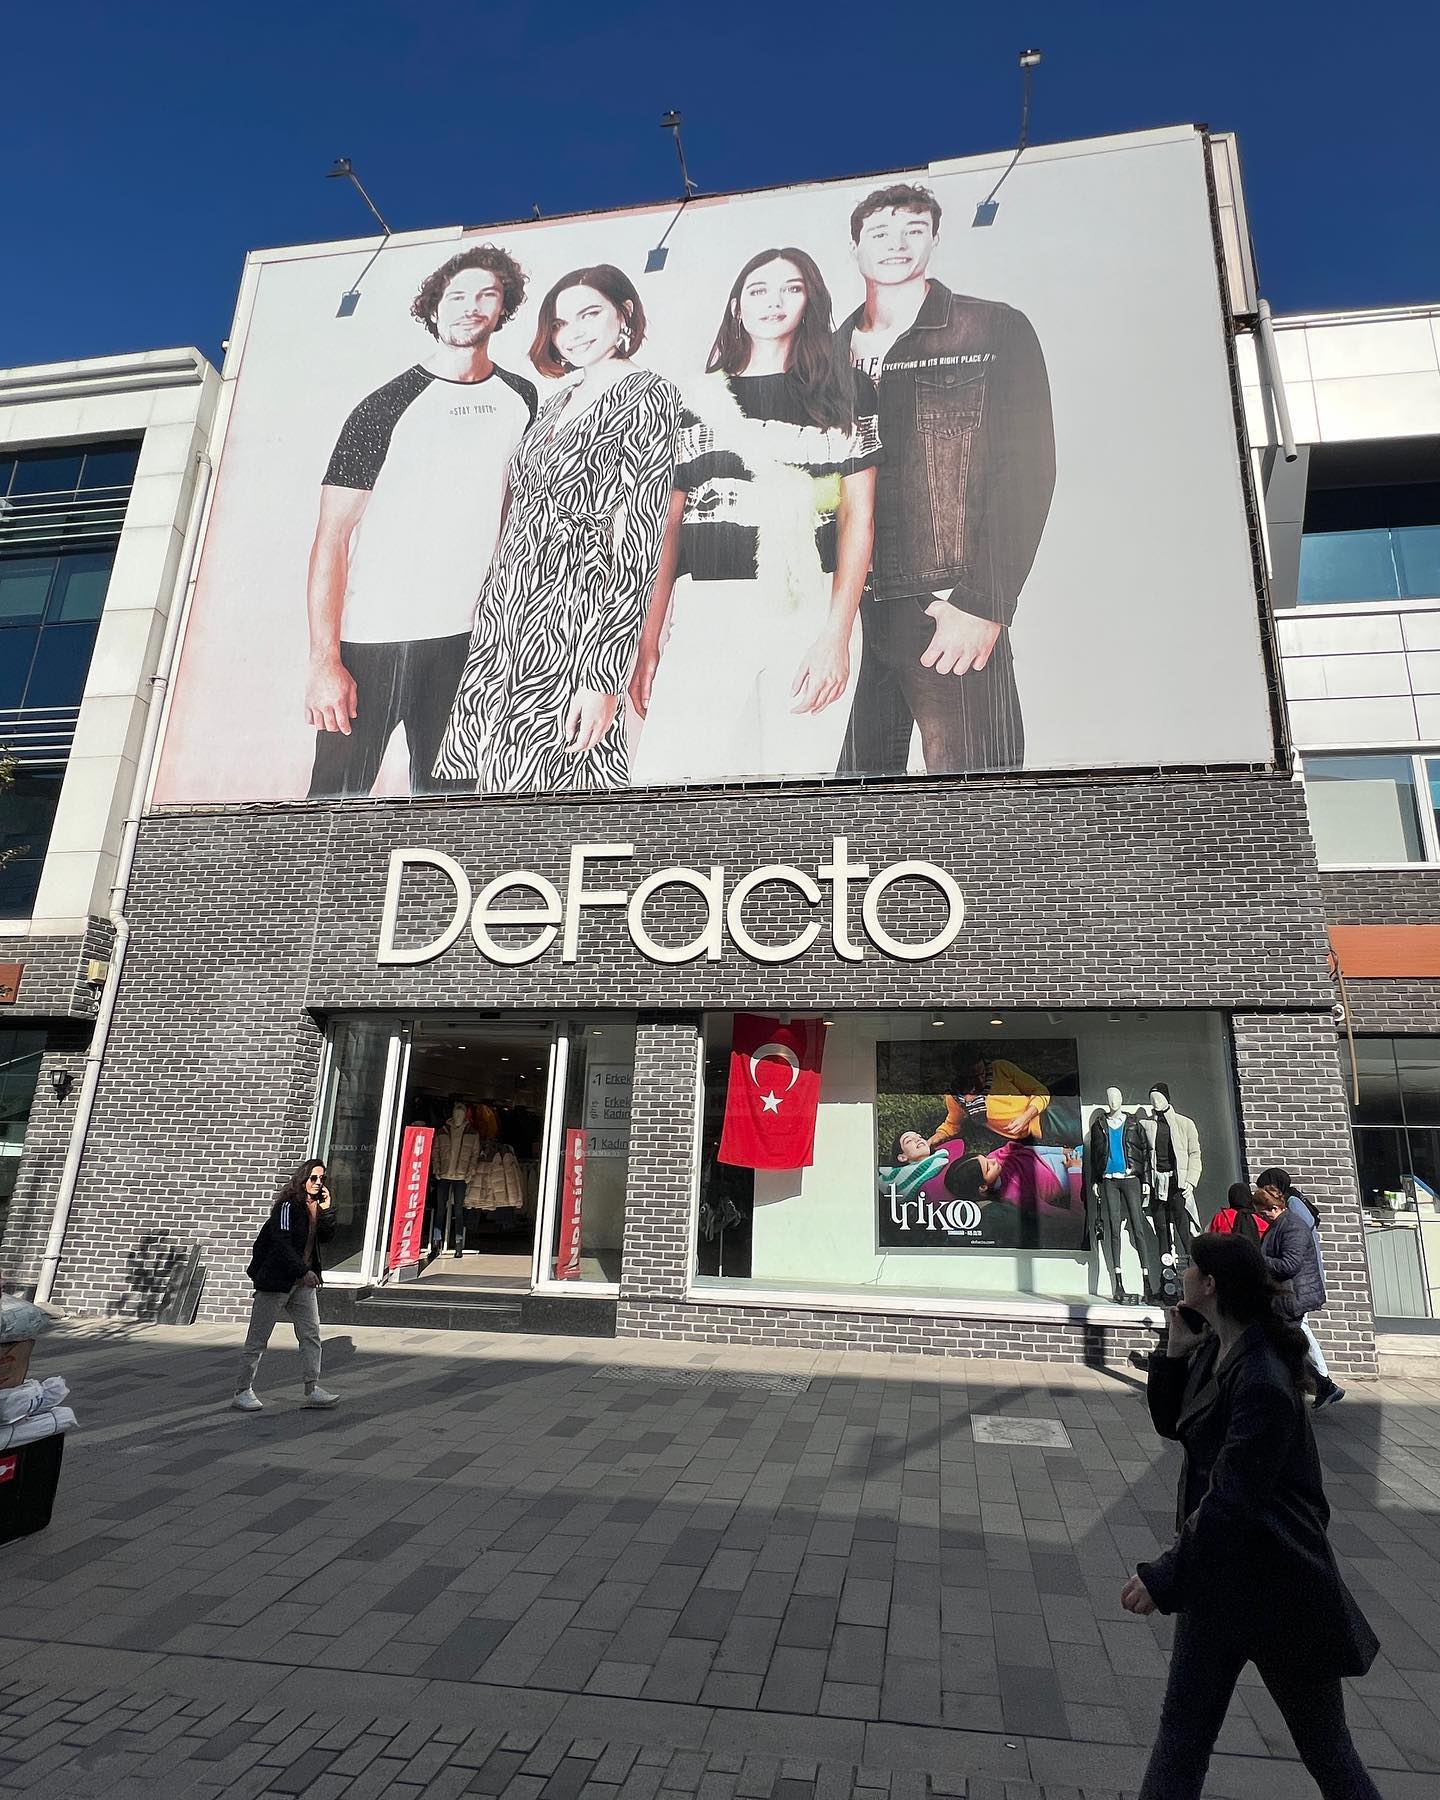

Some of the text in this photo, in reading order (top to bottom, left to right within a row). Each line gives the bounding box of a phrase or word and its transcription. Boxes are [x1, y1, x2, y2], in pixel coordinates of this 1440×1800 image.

[882, 360, 918, 372] EVERYTHING
[919, 359, 927, 368] IN
[928, 357, 938, 367] ITS
[939, 355, 960, 366] RIGHT
[961, 354, 982, 364] PLACE
[377, 836, 966, 966] DeFacto
[605, 1073, 631, 1085] Erkek
